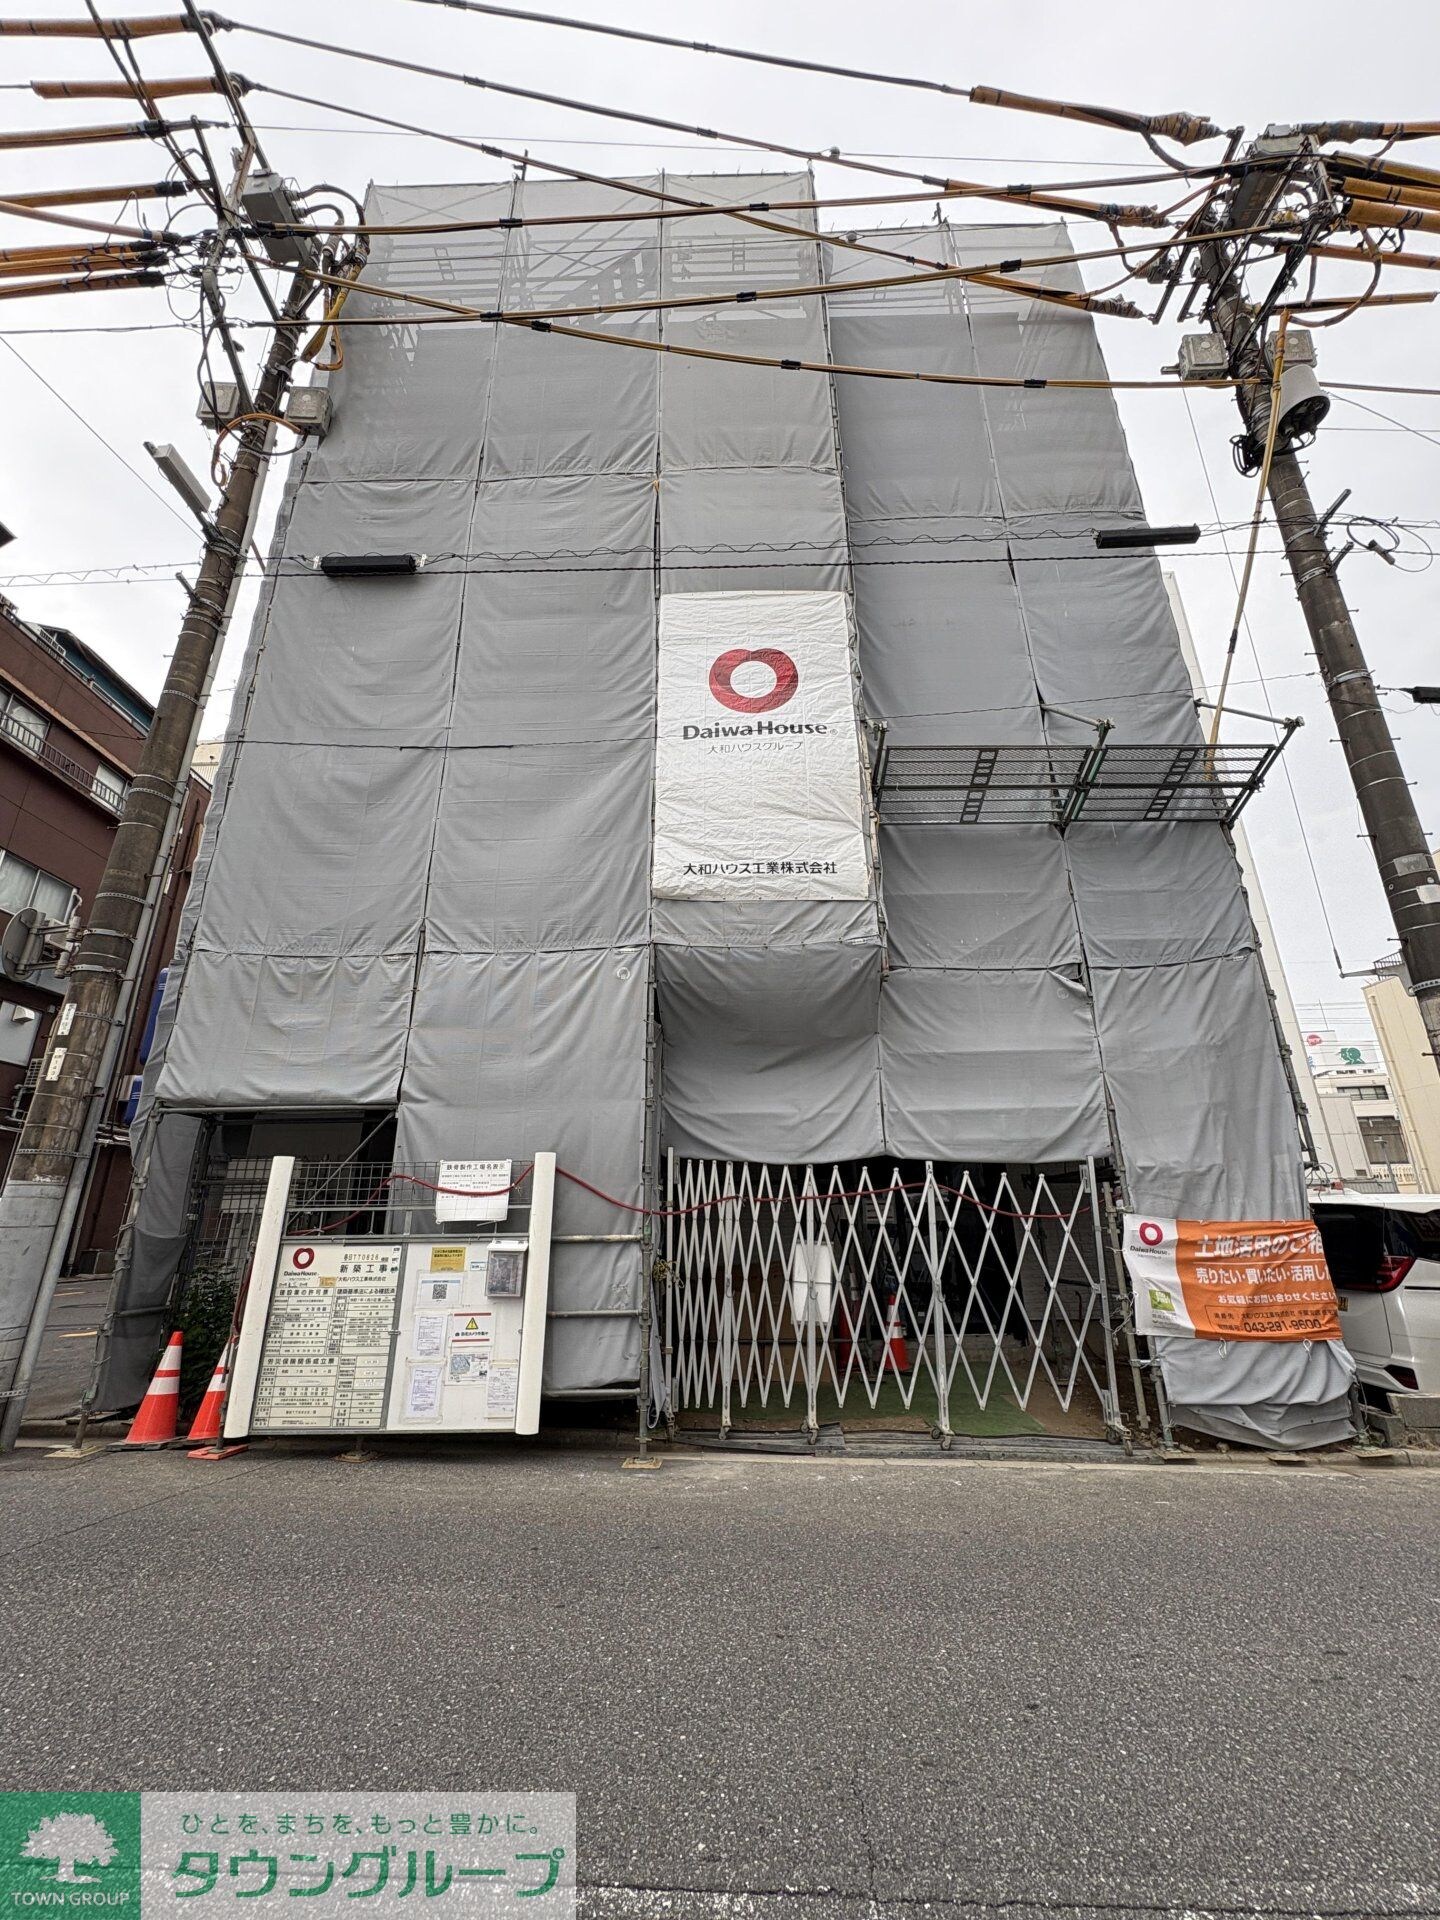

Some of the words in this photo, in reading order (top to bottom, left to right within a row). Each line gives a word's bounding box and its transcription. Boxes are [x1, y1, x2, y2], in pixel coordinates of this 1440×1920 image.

[682, 861, 838, 876] 大和ハウス工業株式会社
[339, 1264, 388, 1273] 新築工事
